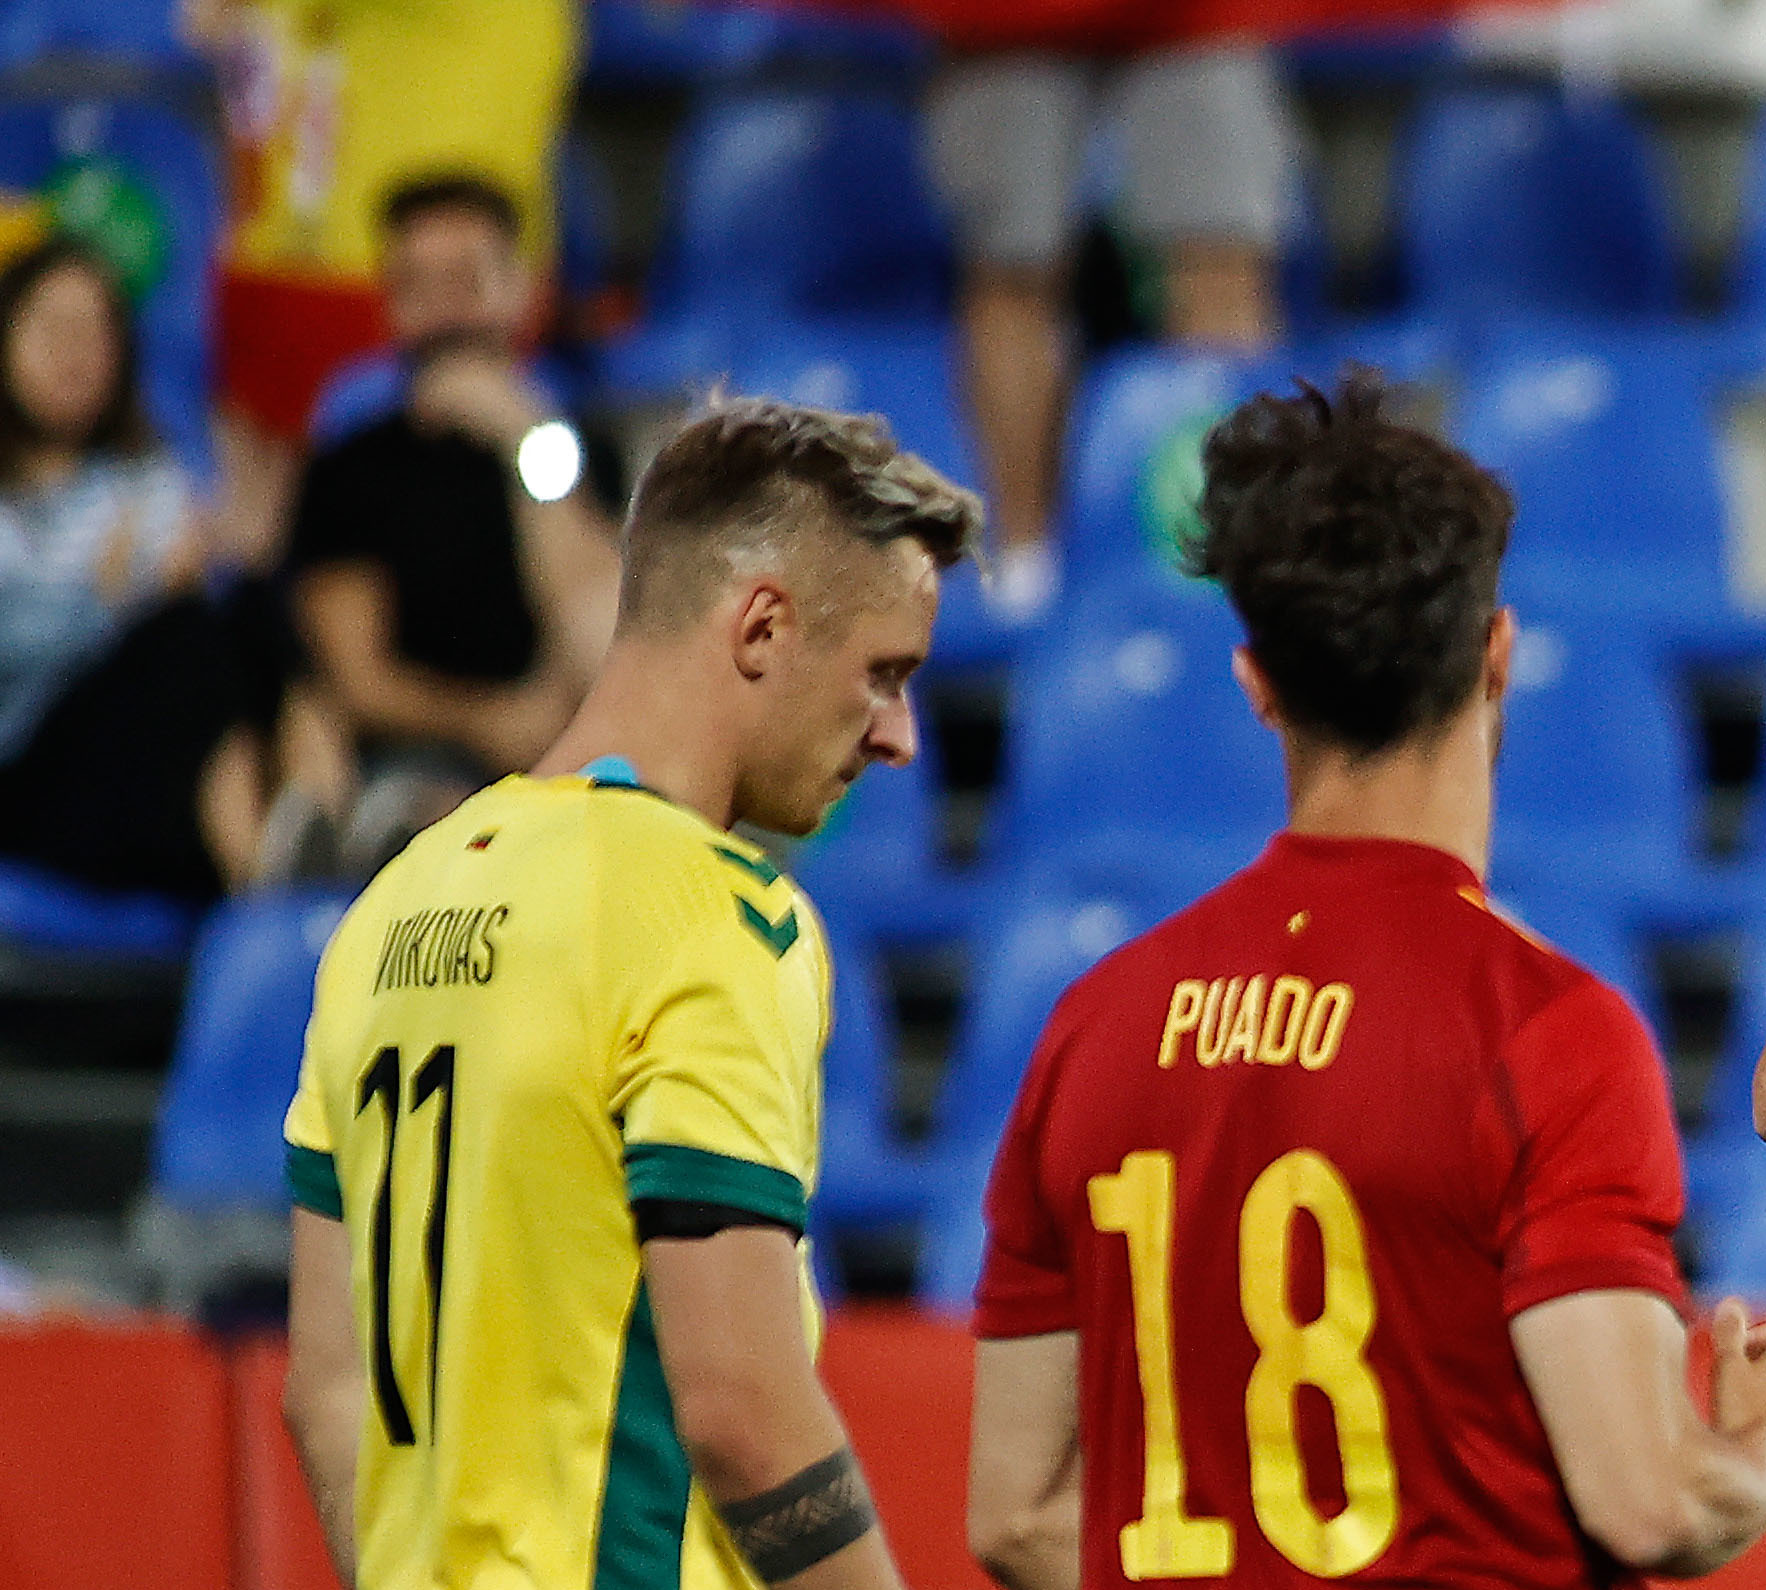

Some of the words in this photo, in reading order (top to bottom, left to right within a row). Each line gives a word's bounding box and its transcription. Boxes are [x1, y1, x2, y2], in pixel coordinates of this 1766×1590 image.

[1157, 974, 1352, 1070] PUADO
[354, 1045, 456, 1446] 11
[1087, 1148, 1399, 1581] 18
